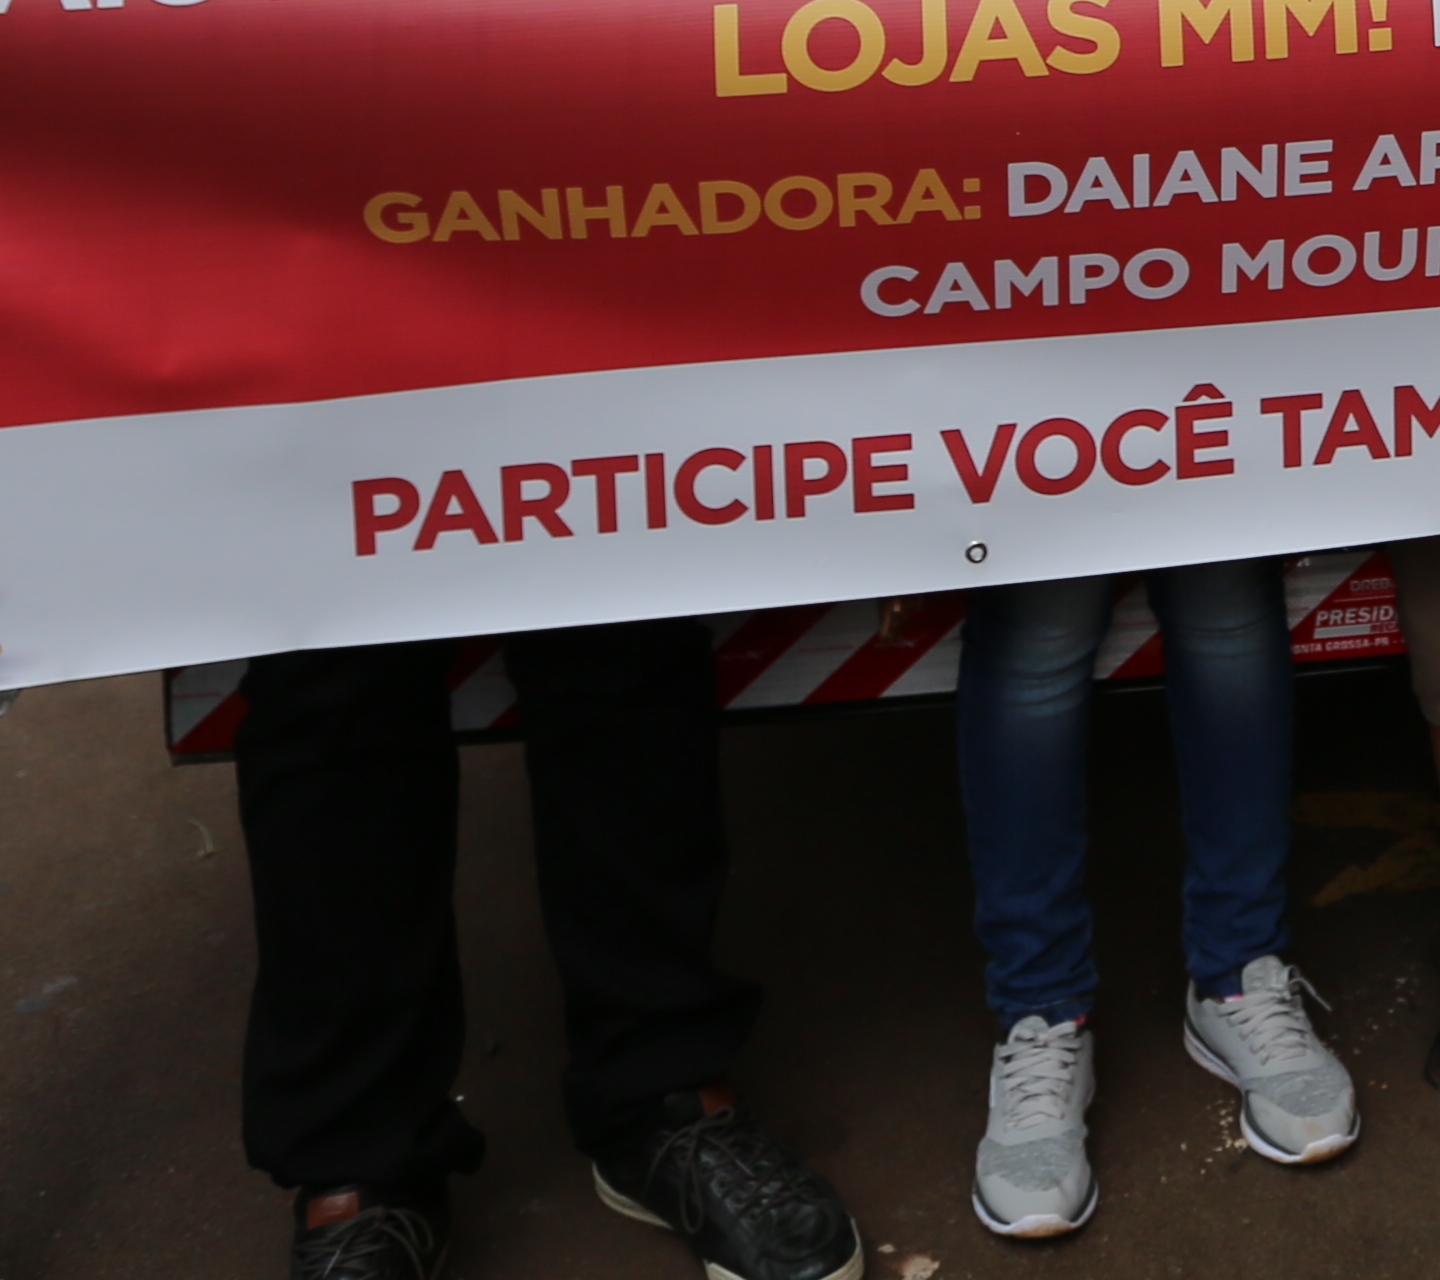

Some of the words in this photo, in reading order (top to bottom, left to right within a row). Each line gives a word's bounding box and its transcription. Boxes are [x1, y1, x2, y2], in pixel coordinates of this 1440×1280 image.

[362, 166, 982, 245] GANHADORA:
[1005, 138, 1335, 218] DAIANE
[859, 246, 1191, 320] CAMPO
[351, 431, 917, 558] PARTICIPE
[938, 380, 1236, 506] VOCÊ
[1315, 604, 1395, 628] PRESID
